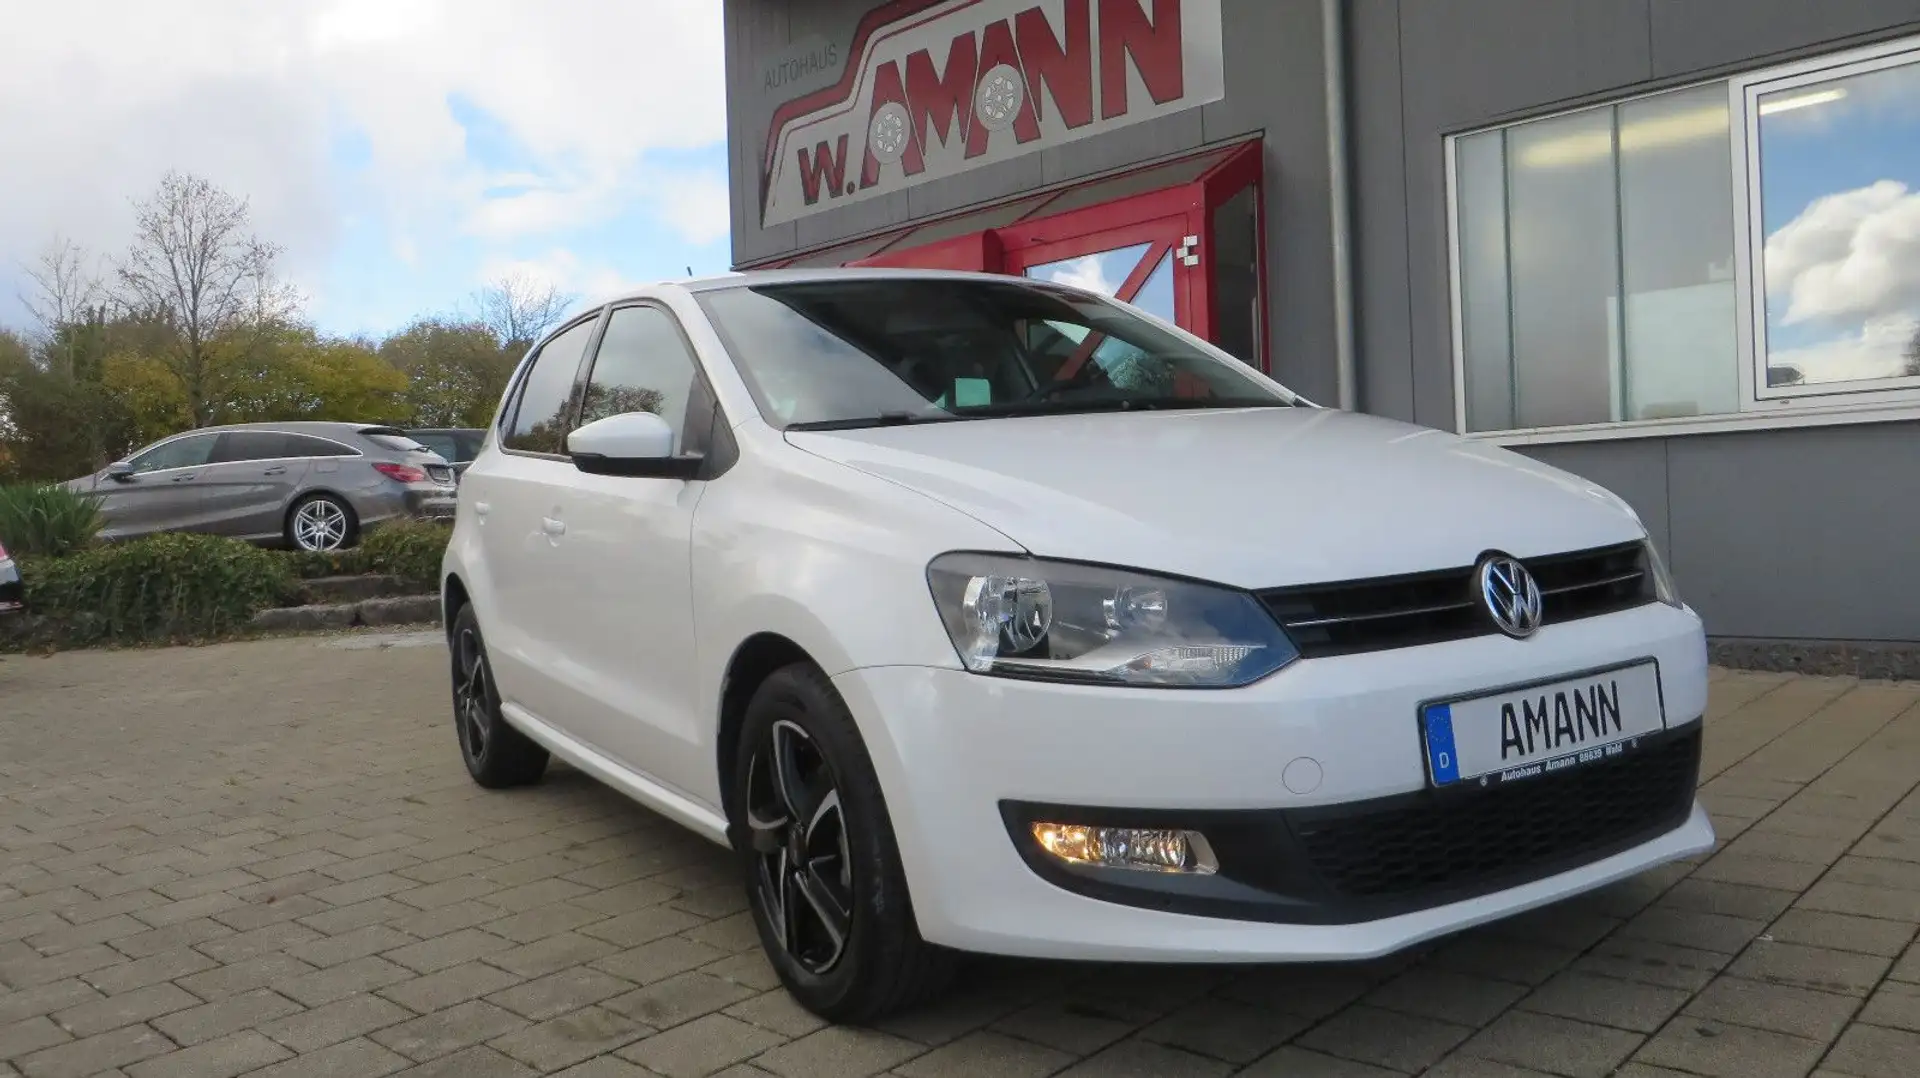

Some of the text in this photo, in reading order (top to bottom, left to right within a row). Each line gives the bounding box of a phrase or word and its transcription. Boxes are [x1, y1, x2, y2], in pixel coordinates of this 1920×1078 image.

[764, 43, 837, 97] AUTOHAUS
[1501, 680, 1622, 760] AMANN
[1439, 751, 1450, 769] D
[1501, 765, 1541, 782] Autohaus
[1545, 756, 1576, 772] Amann
[1605, 743, 1623, 756] Wald
